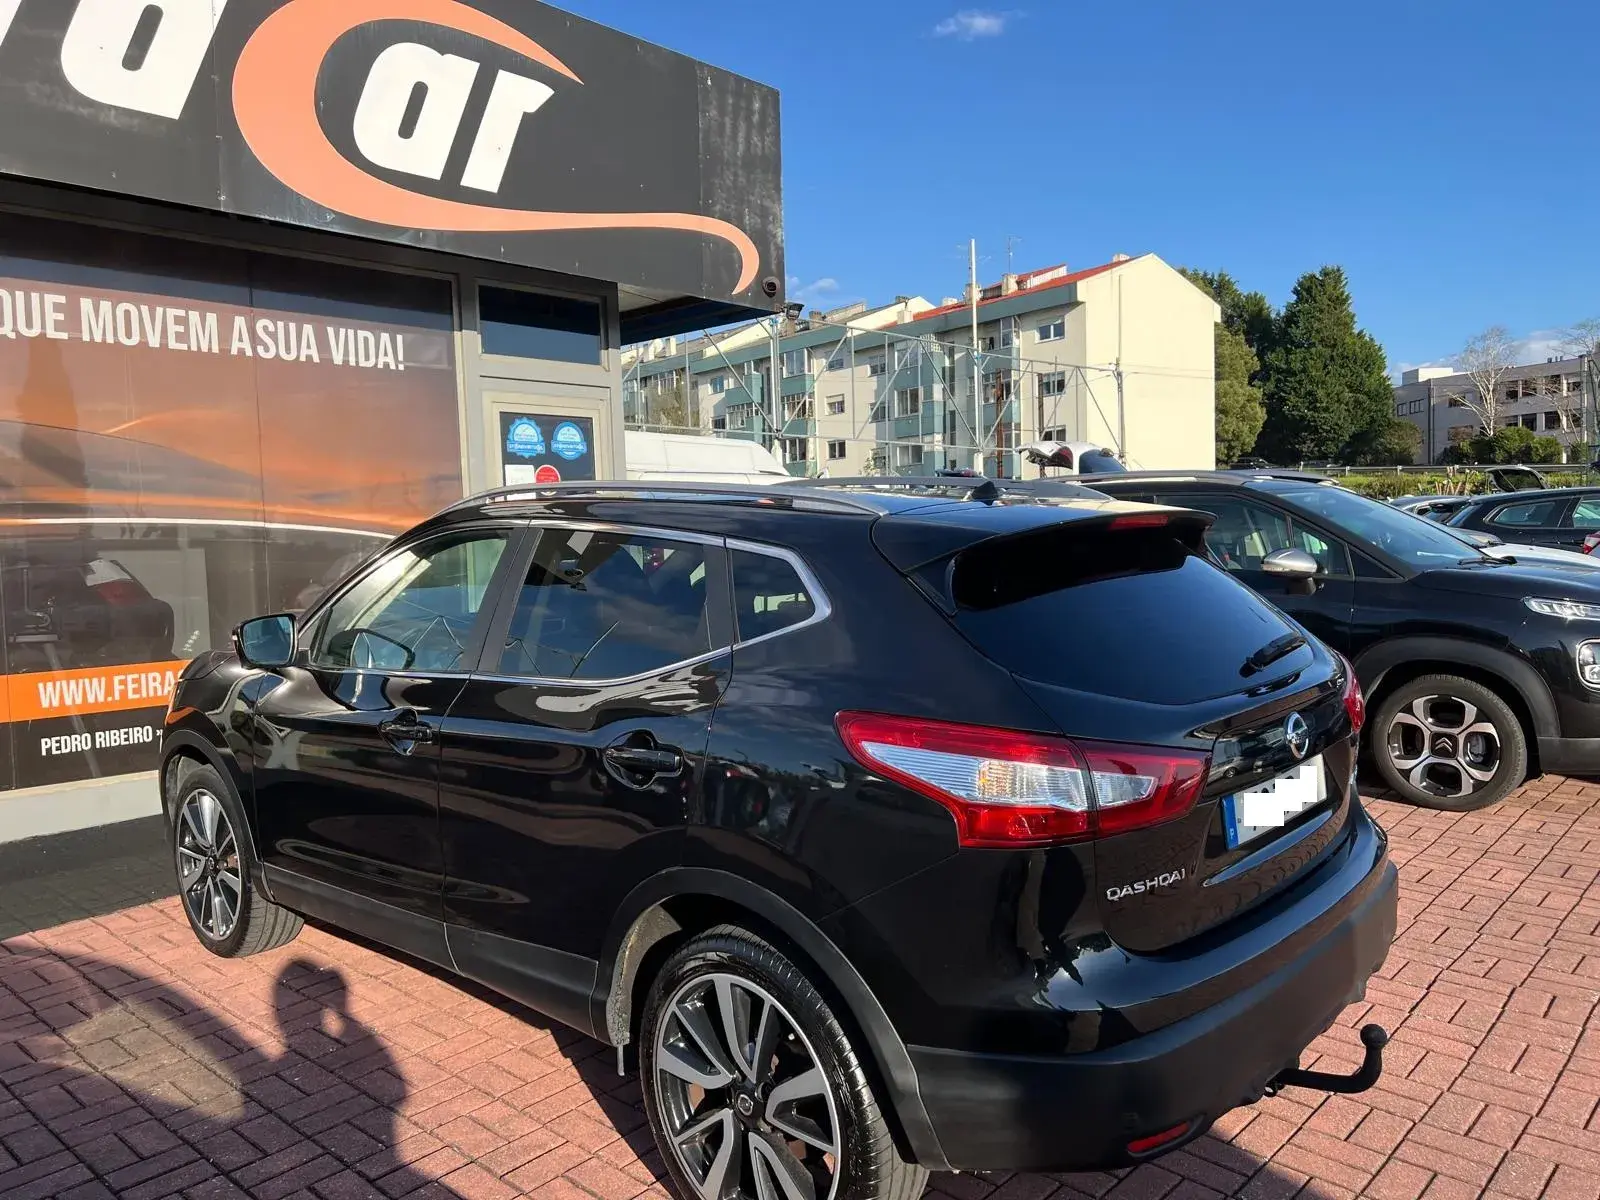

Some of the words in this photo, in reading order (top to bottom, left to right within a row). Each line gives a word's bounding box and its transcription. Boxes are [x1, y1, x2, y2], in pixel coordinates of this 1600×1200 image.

[0, 289, 69, 340] QUE
[79, 297, 219, 354] MOVEM
[230, 315, 253, 357] A
[256, 318, 320, 363] SUA
[326, 326, 405, 371] VIDA!
[38, 669, 185, 709] WWW.FEIRA
[40, 732, 92, 757] PEDRO
[95, 725, 153, 750] RIBEIRO
[1106, 868, 1186, 901] QASHQAI
